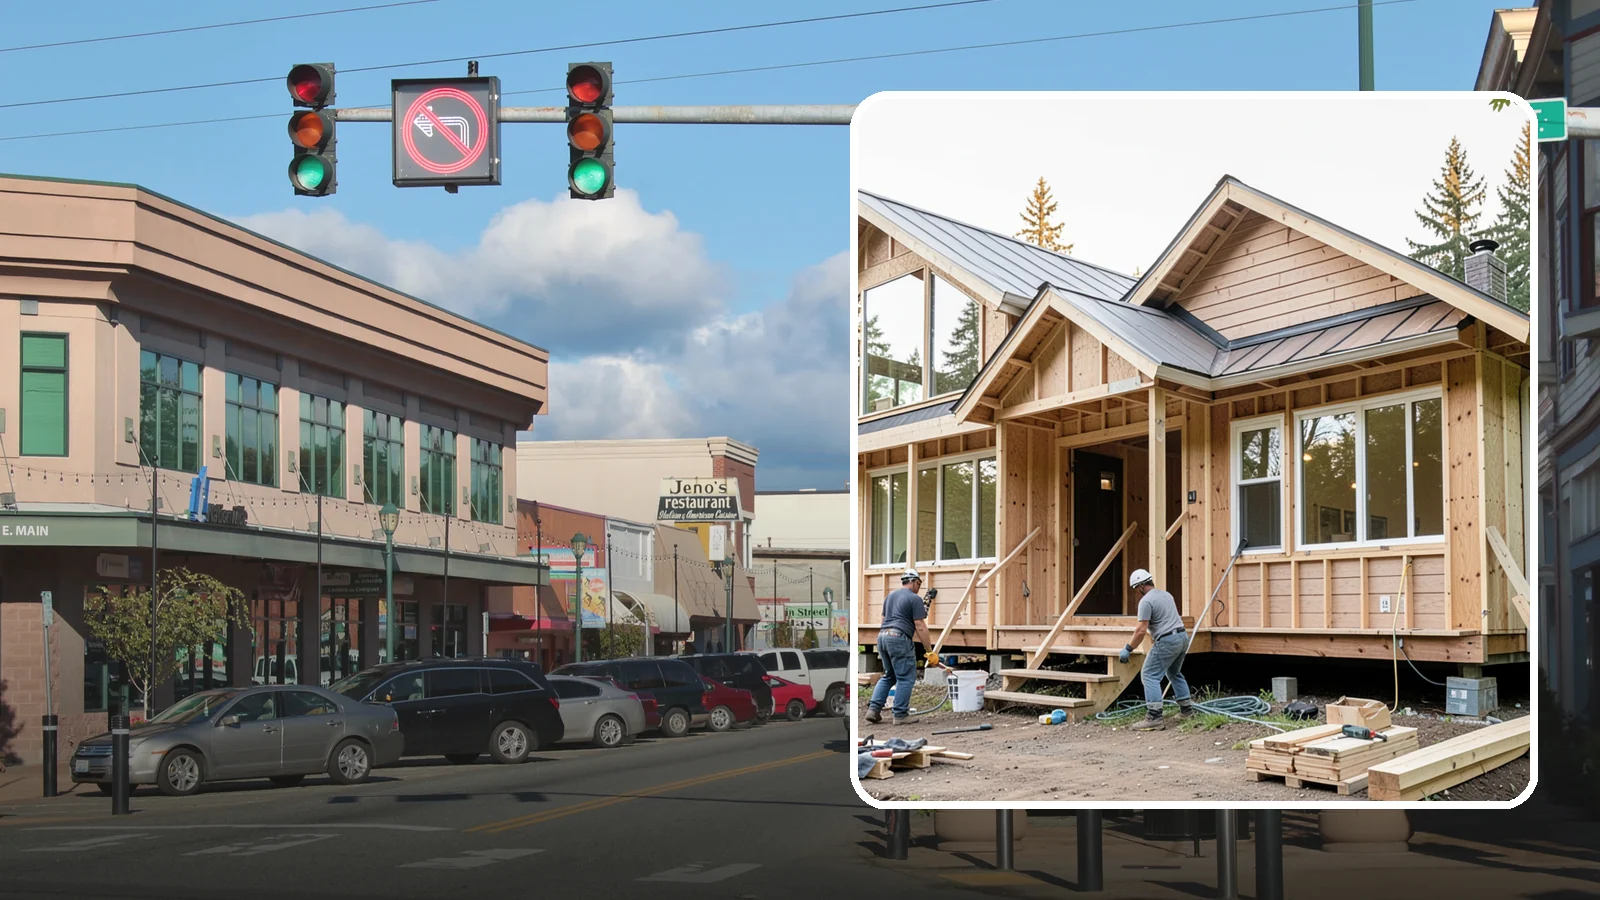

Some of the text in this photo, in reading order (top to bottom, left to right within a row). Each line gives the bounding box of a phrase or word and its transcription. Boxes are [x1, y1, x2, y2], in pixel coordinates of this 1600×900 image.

[670, 480, 727, 494] Jeno's
[665, 496, 731, 509] restaurant
[686, 509, 714, 519] American
[715, 509, 737, 519] Cuisine
[2, 525, 49, 536] E. MAIN
